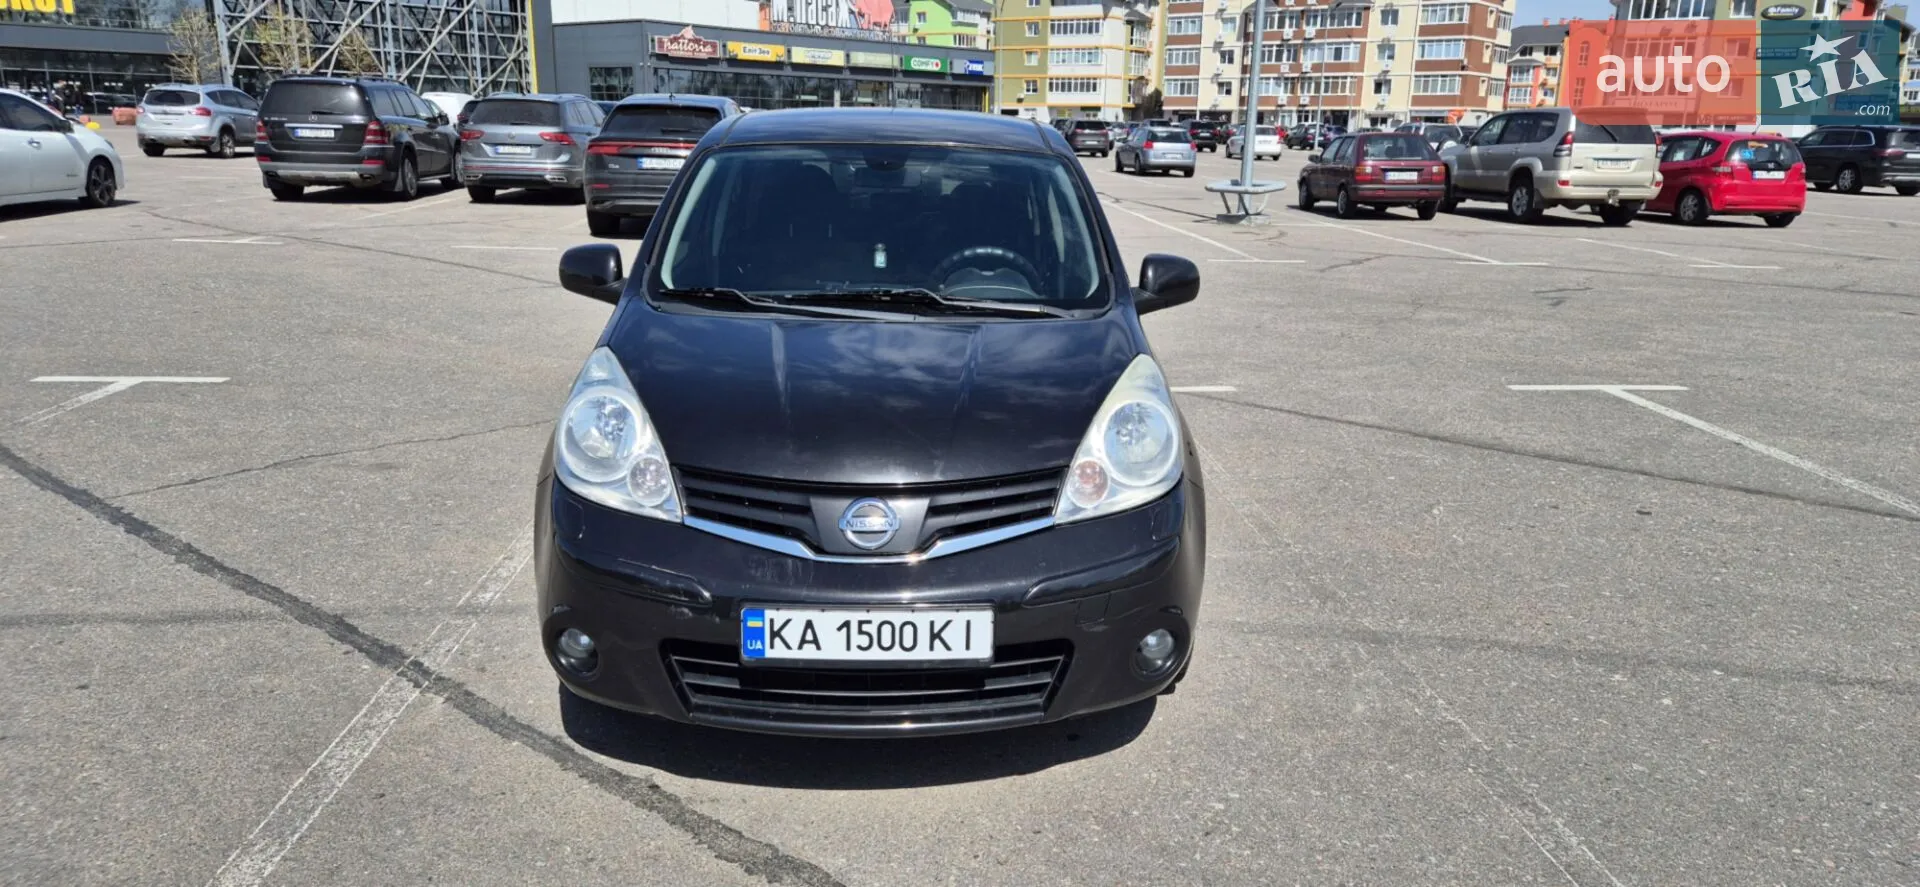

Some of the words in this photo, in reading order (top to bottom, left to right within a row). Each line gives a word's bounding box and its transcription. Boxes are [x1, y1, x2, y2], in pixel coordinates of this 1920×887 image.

[662, 38, 713, 54] Trattoria
[846, 519, 893, 528] NISSAN
[769, 618, 821, 650] KA
[836, 620, 918, 652] 1500
[747, 640, 763, 650] UA
